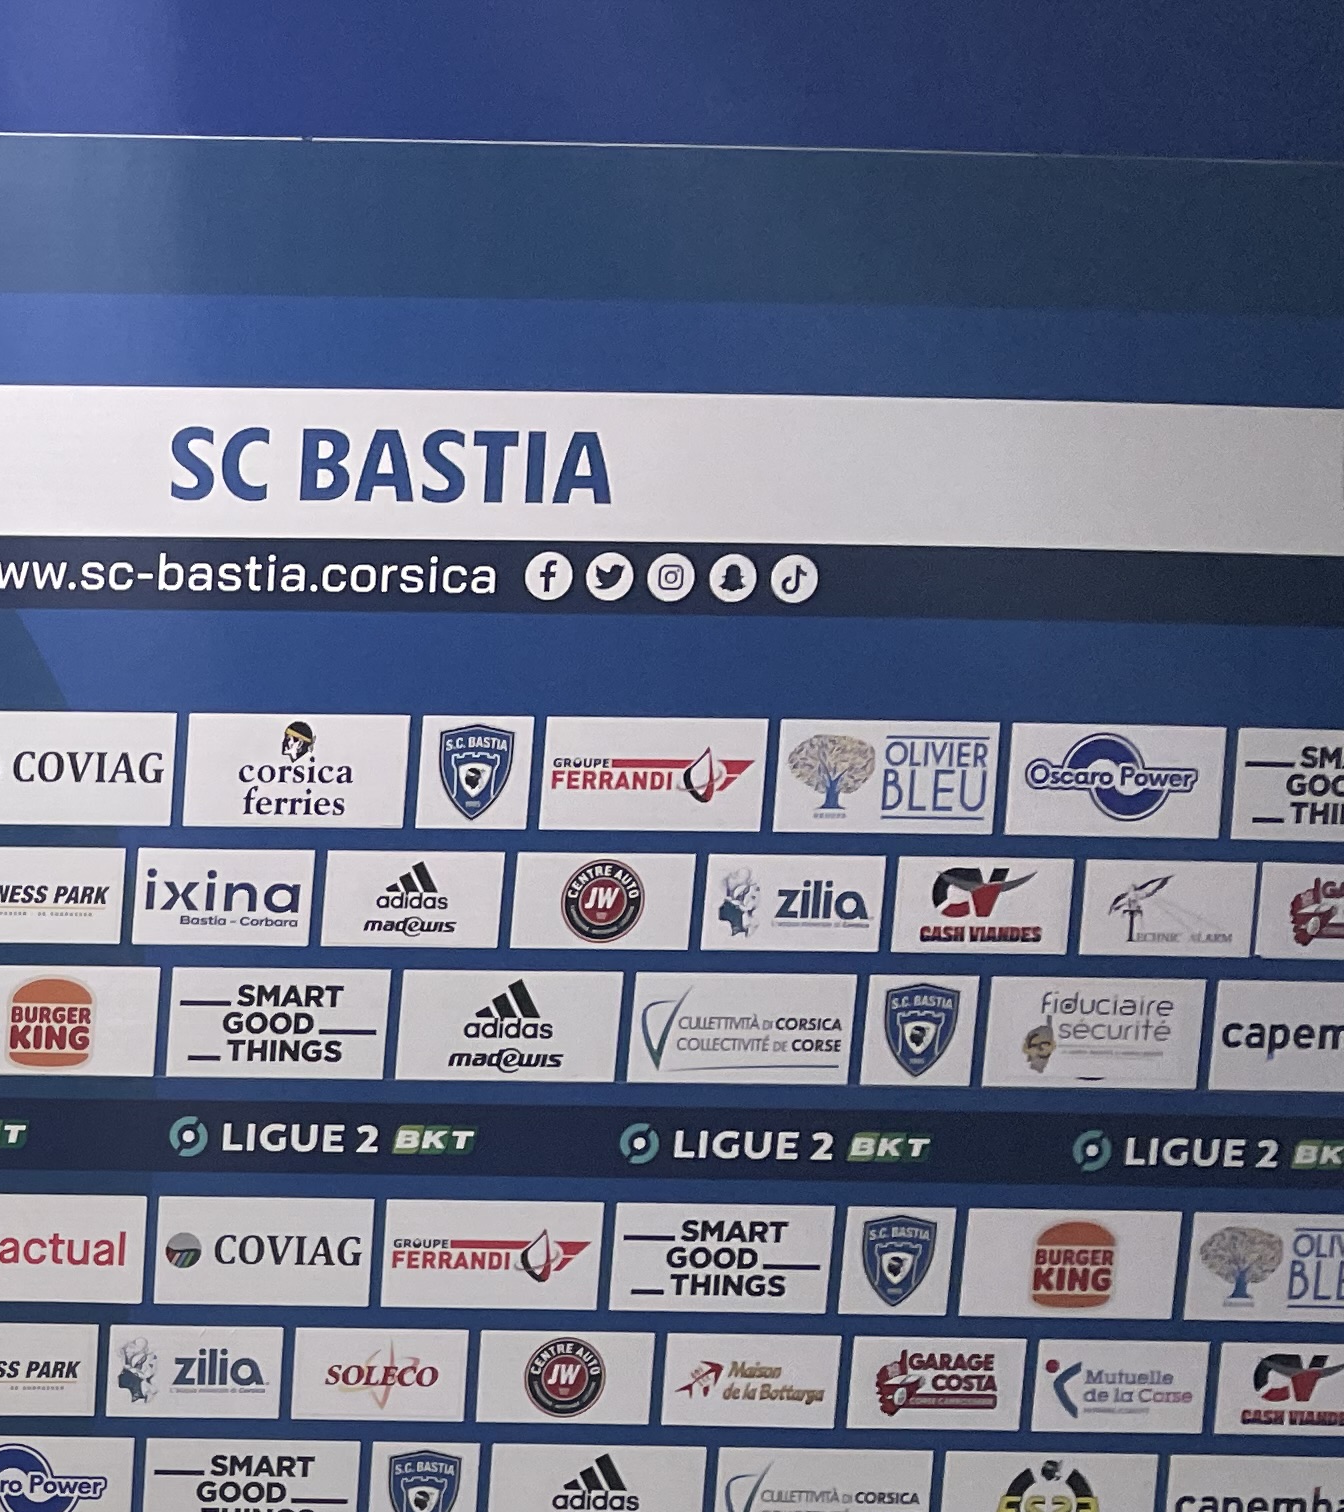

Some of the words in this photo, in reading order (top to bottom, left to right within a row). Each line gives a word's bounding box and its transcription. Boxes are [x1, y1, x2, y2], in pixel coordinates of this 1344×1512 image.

[170, 426, 270, 501] SC
[300, 429, 612, 505] BASTIA
[468, 736, 508, 752] BASTIA
[885, 741, 987, 767] OLIVIER
[13, 751, 164, 784] COVIAG
[238, 757, 353, 784] corsica
[554, 757, 610, 768] GROUPE
[551, 770, 673, 791] FERRANDI
[1030, 767, 1112, 786] Oscaro
[1120, 767, 1194, 789] Power
[242, 786, 346, 816] ferries
[882, 770, 987, 811] BLEU
[143, 868, 302, 913] ixina
[568, 865, 611, 898] CENTRE
[613, 870, 640, 899] AUTO
[53, 886, 109, 905] PARK
[376, 892, 449, 910] adidas
[584, 887, 619, 909] JW
[774, 880, 868, 920] zilia
[180, 916, 226, 927] Bastia
[239, 916, 298, 928] Corbara
[920, 926, 965, 942] CASH
[969, 926, 1042, 943] VIANDES
[238, 985, 344, 1008] SMART
[1041, 992, 1174, 1017] fiduciaire
[12, 1006, 91, 1024] BURGER
[222, 1012, 313, 1035] GOOD
[11, 1026, 90, 1050] KING
[463, 1017, 554, 1039] adidas
[1058, 1019, 1172, 1041] sécurité
[227, 1040, 342, 1063] THINGS
[672, 1128, 801, 1161] LIGUE
[809, 1132, 834, 1163] 2
[849, 1134, 930, 1159] BKT
[681, 1220, 788, 1243] SMART
[214, 1235, 362, 1267] COVIAG
[393, 1238, 449, 1248] GROUPE
[392, 1250, 510, 1271] FERRANDI
[666, 1247, 758, 1270] GOOD
[1035, 1248, 1114, 1266] BURGER
[670, 1274, 786, 1297] THINGS
[1033, 1268, 1112, 1292] KING
[26, 1362, 81, 1379] PARK
[172, 1349, 264, 1385] zilia
[728, 1361, 782, 1379] Maison
[908, 1353, 995, 1372] GARAGE
[325, 1364, 438, 1388] SOLECO
[932, 1374, 997, 1392] COSTA
[1084, 1369, 1173, 1386] Mutuelle
[1083, 1387, 1109, 1403] de
[1113, 1388, 1134, 1403] la
[1139, 1389, 1193, 1403] Corse
[211, 1455, 316, 1477] SMART
[196, 1482, 286, 1503] GOOD
[552, 1492, 639, 1511] adidas
